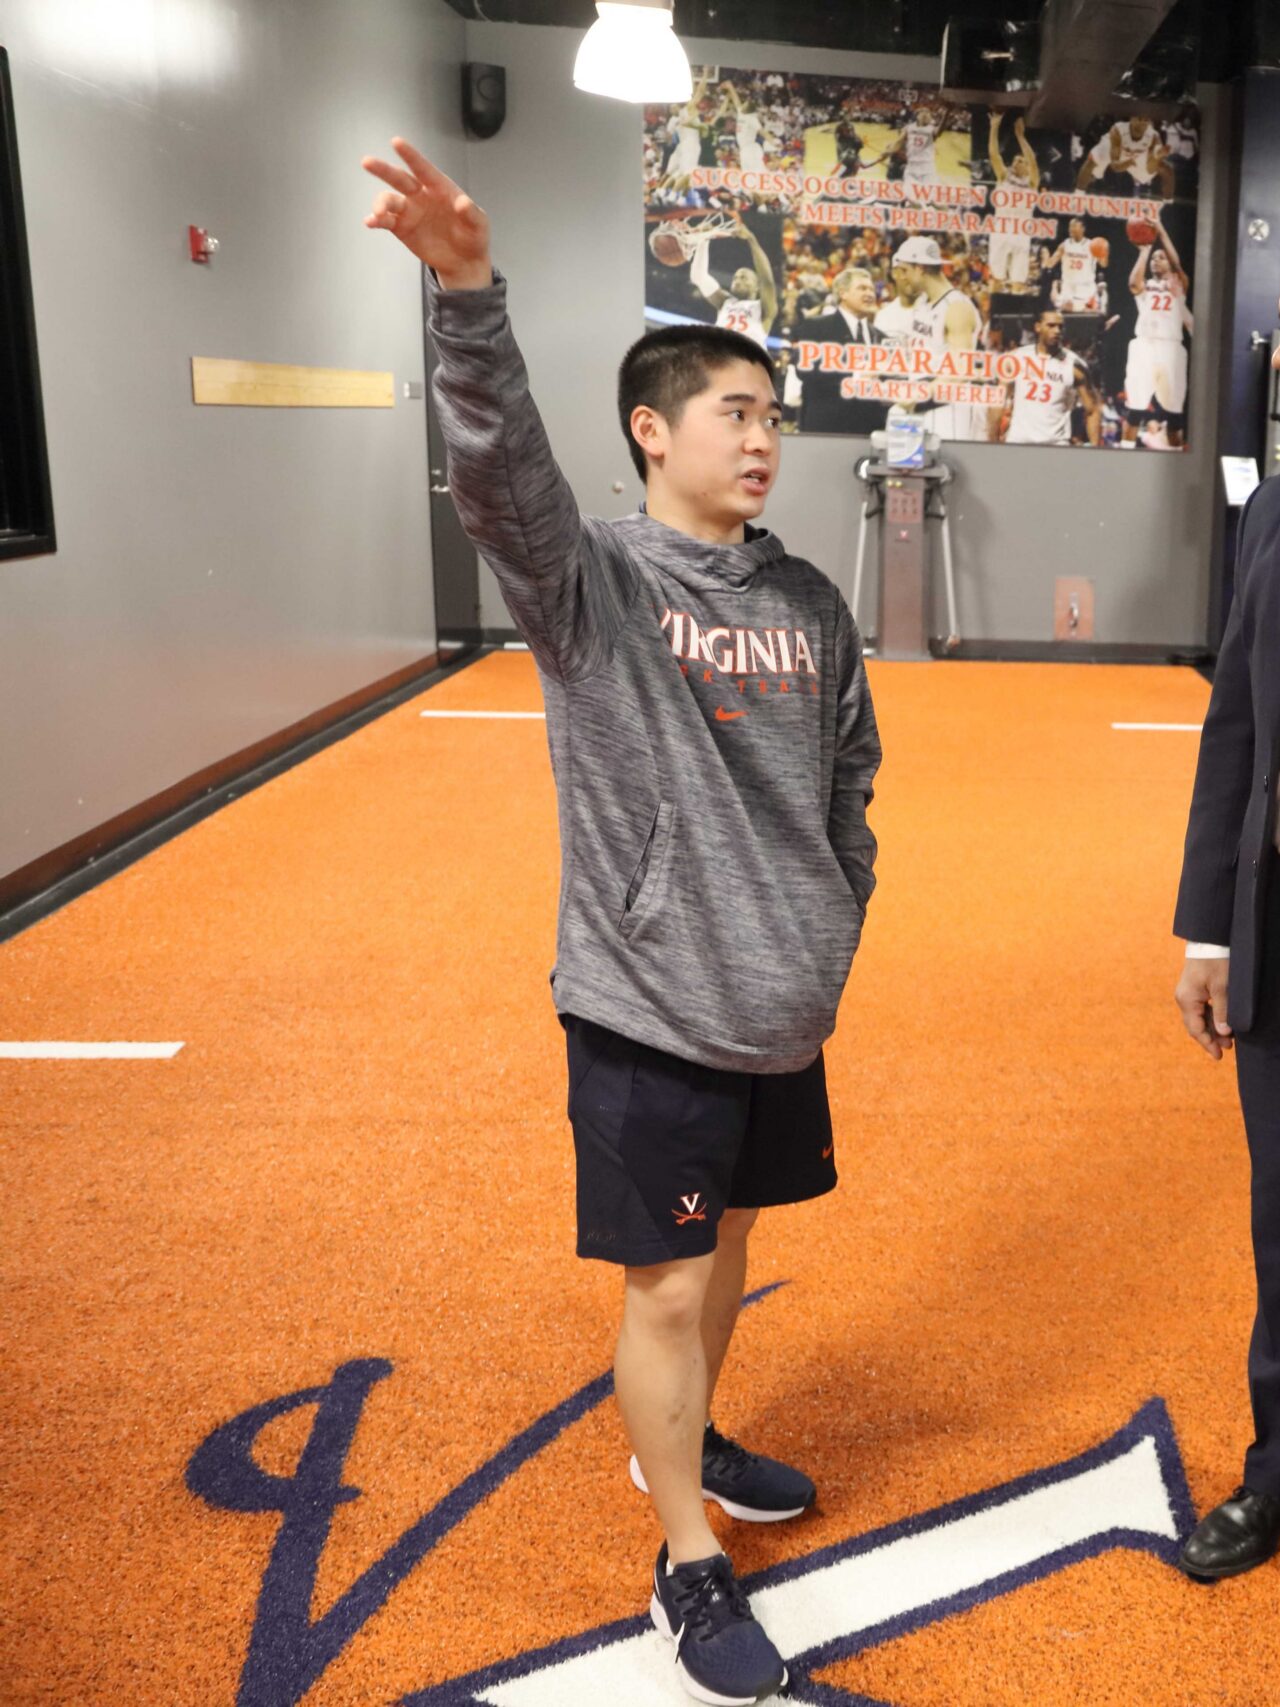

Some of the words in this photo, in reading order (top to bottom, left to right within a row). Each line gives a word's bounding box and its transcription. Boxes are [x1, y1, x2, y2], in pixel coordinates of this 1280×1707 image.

[691, 168, 798, 193] SUCCESS
[803, 176, 905, 200] OCCURS
[912, 184, 984, 206] WHEN
[992, 190, 1161, 220] OPPORTUNITY
[803, 203, 884, 225] MEETS
[890, 209, 1056, 237] PREPARATION
[1151, 295, 1172, 311] 22
[726, 314, 748, 331] 25
[800, 343, 1047, 381] PREPARATION
[841, 379, 929, 400] STARTS
[937, 384, 1007, 405] HERE!
[1025, 381, 1052, 403] 23
[680, 1192, 700, 1215] V
